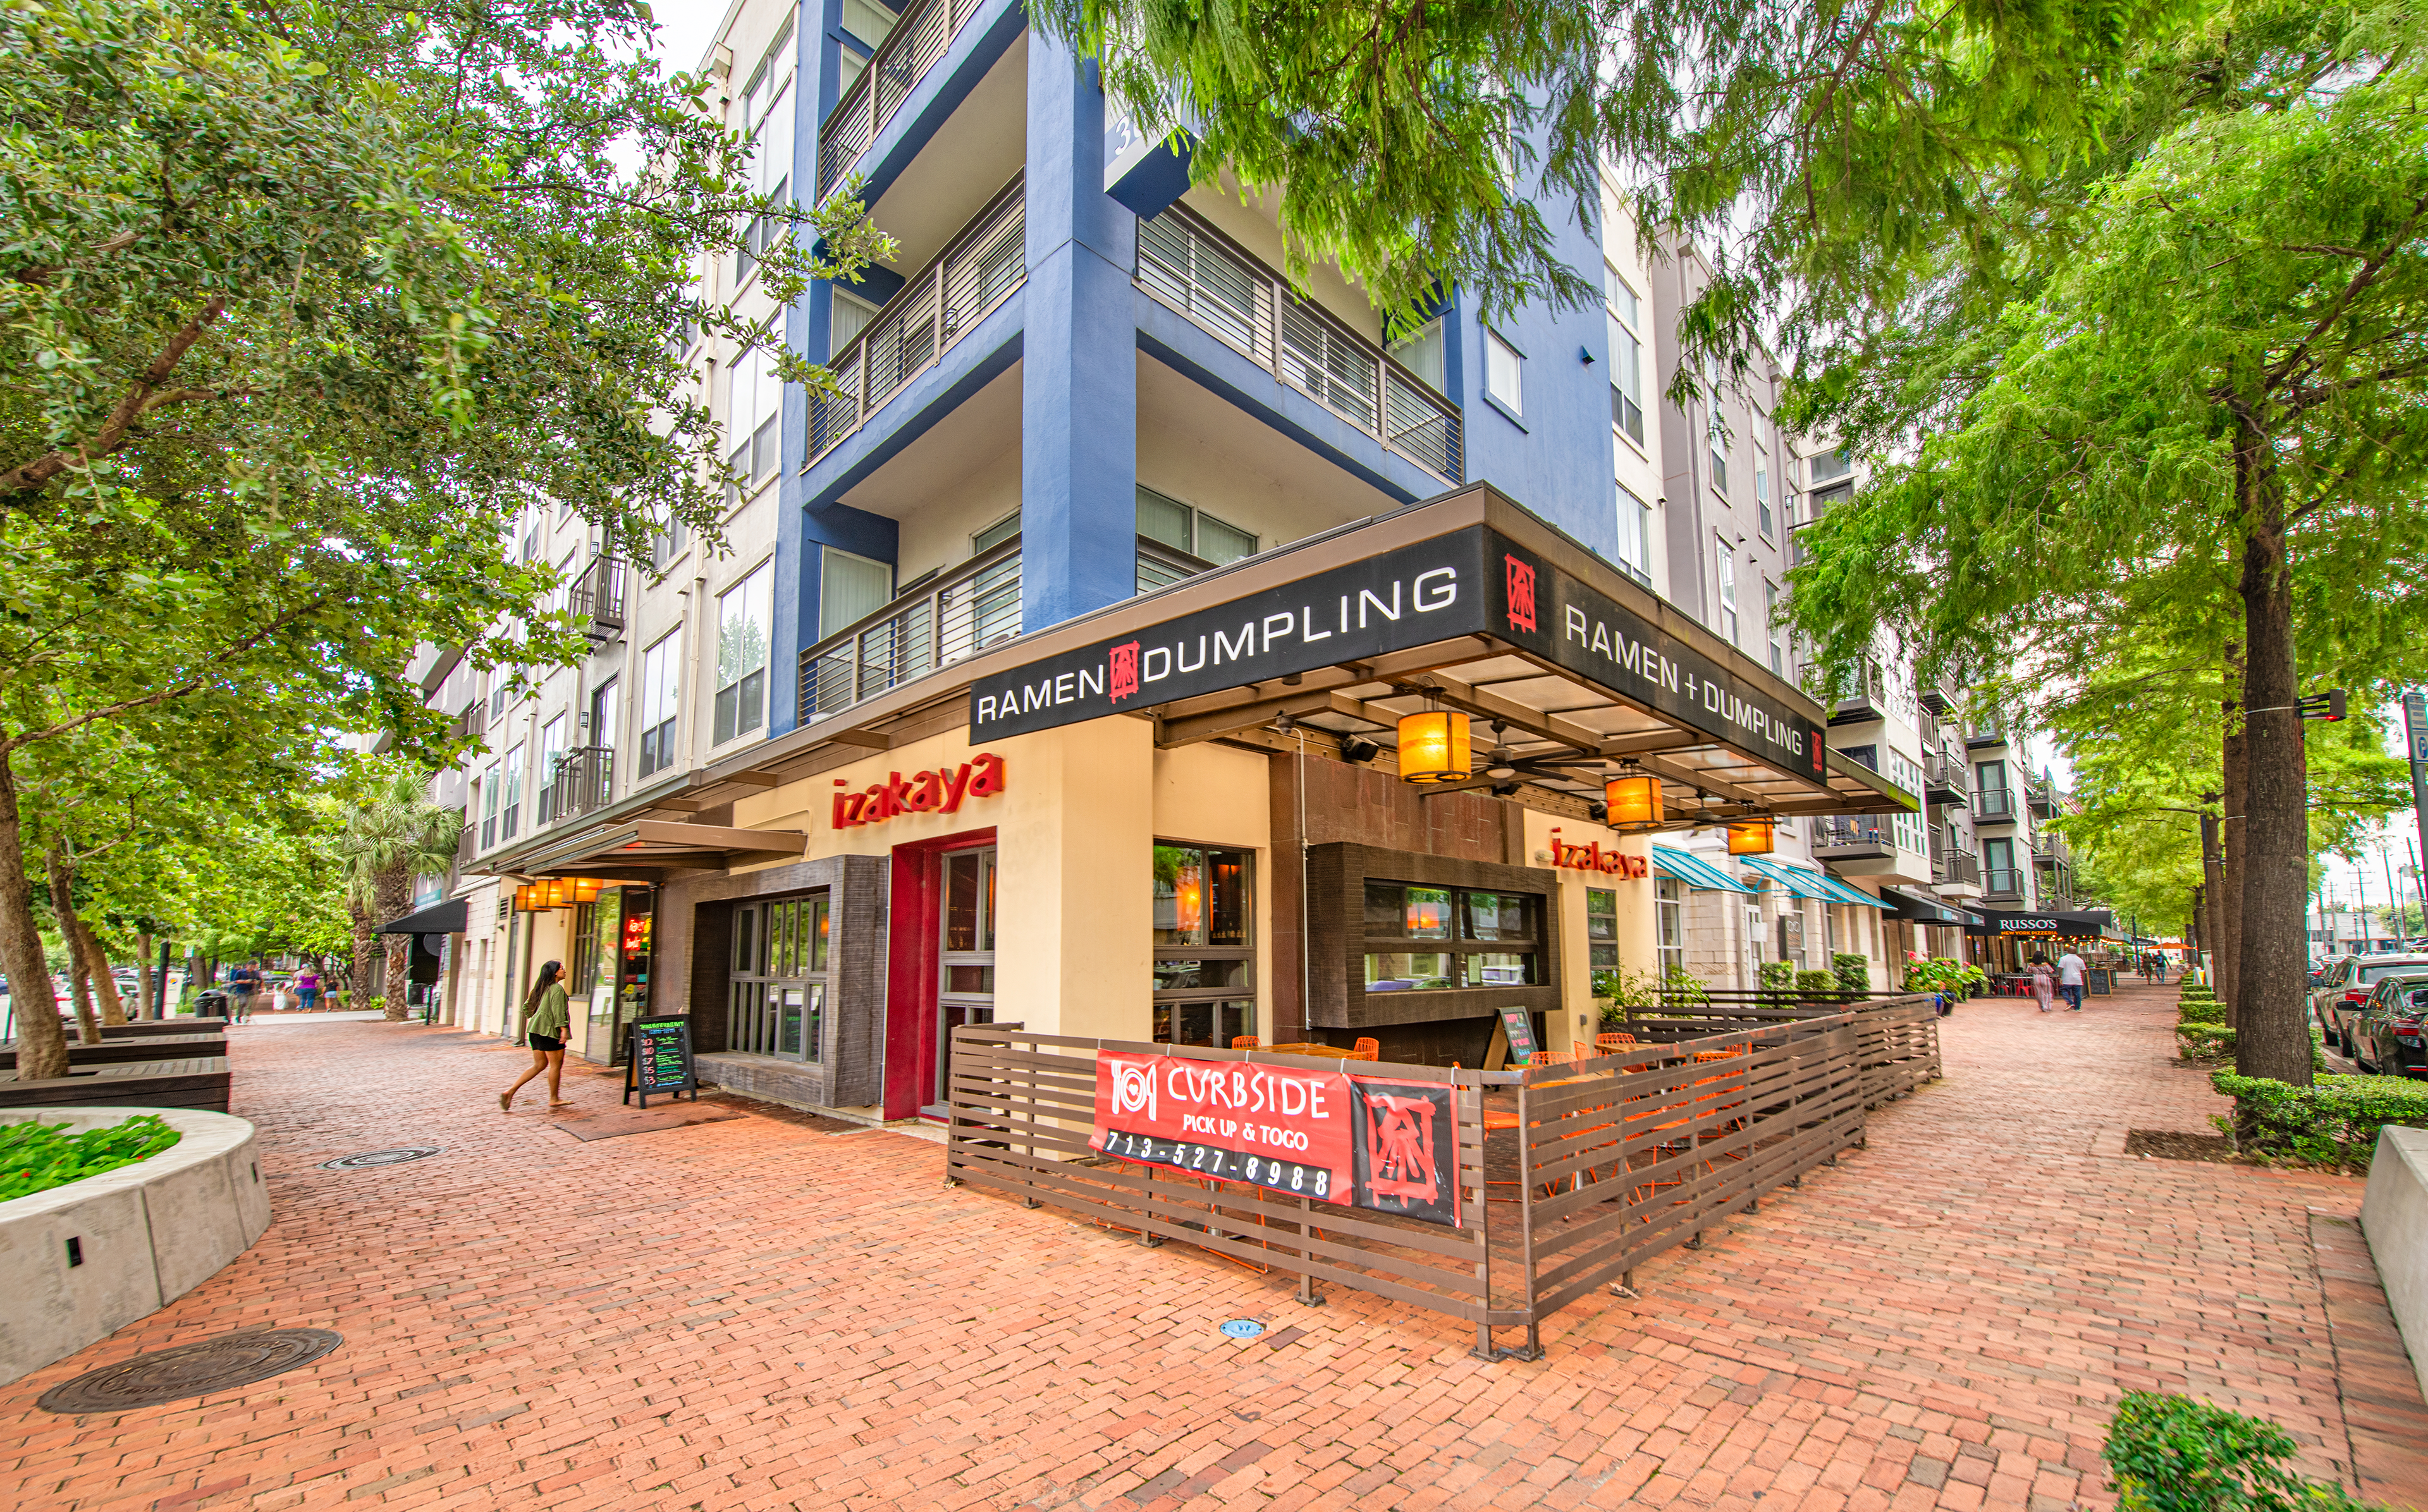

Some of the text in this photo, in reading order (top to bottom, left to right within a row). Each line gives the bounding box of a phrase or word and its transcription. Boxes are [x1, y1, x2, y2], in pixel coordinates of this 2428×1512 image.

[978, 566, 1457, 724] RAMEN DUMPLING
[1565, 604, 1679, 694] RAMEN
[1703, 680, 1803, 756] DUMPLING
[832, 752, 1004, 829] izakaya
[1552, 827, 1648, 881] izakaya
[1999, 919, 2058, 931] RUSSO'S
[642, 1066, 655, 1074] $5
[644, 1076, 656, 1085] $3
[1167, 1066, 1330, 1119] CURBSIDE
[1183, 1114, 1309, 1151] PICK UP & TOGO
[1106, 1131, 1328, 1197] 713-527-8988
